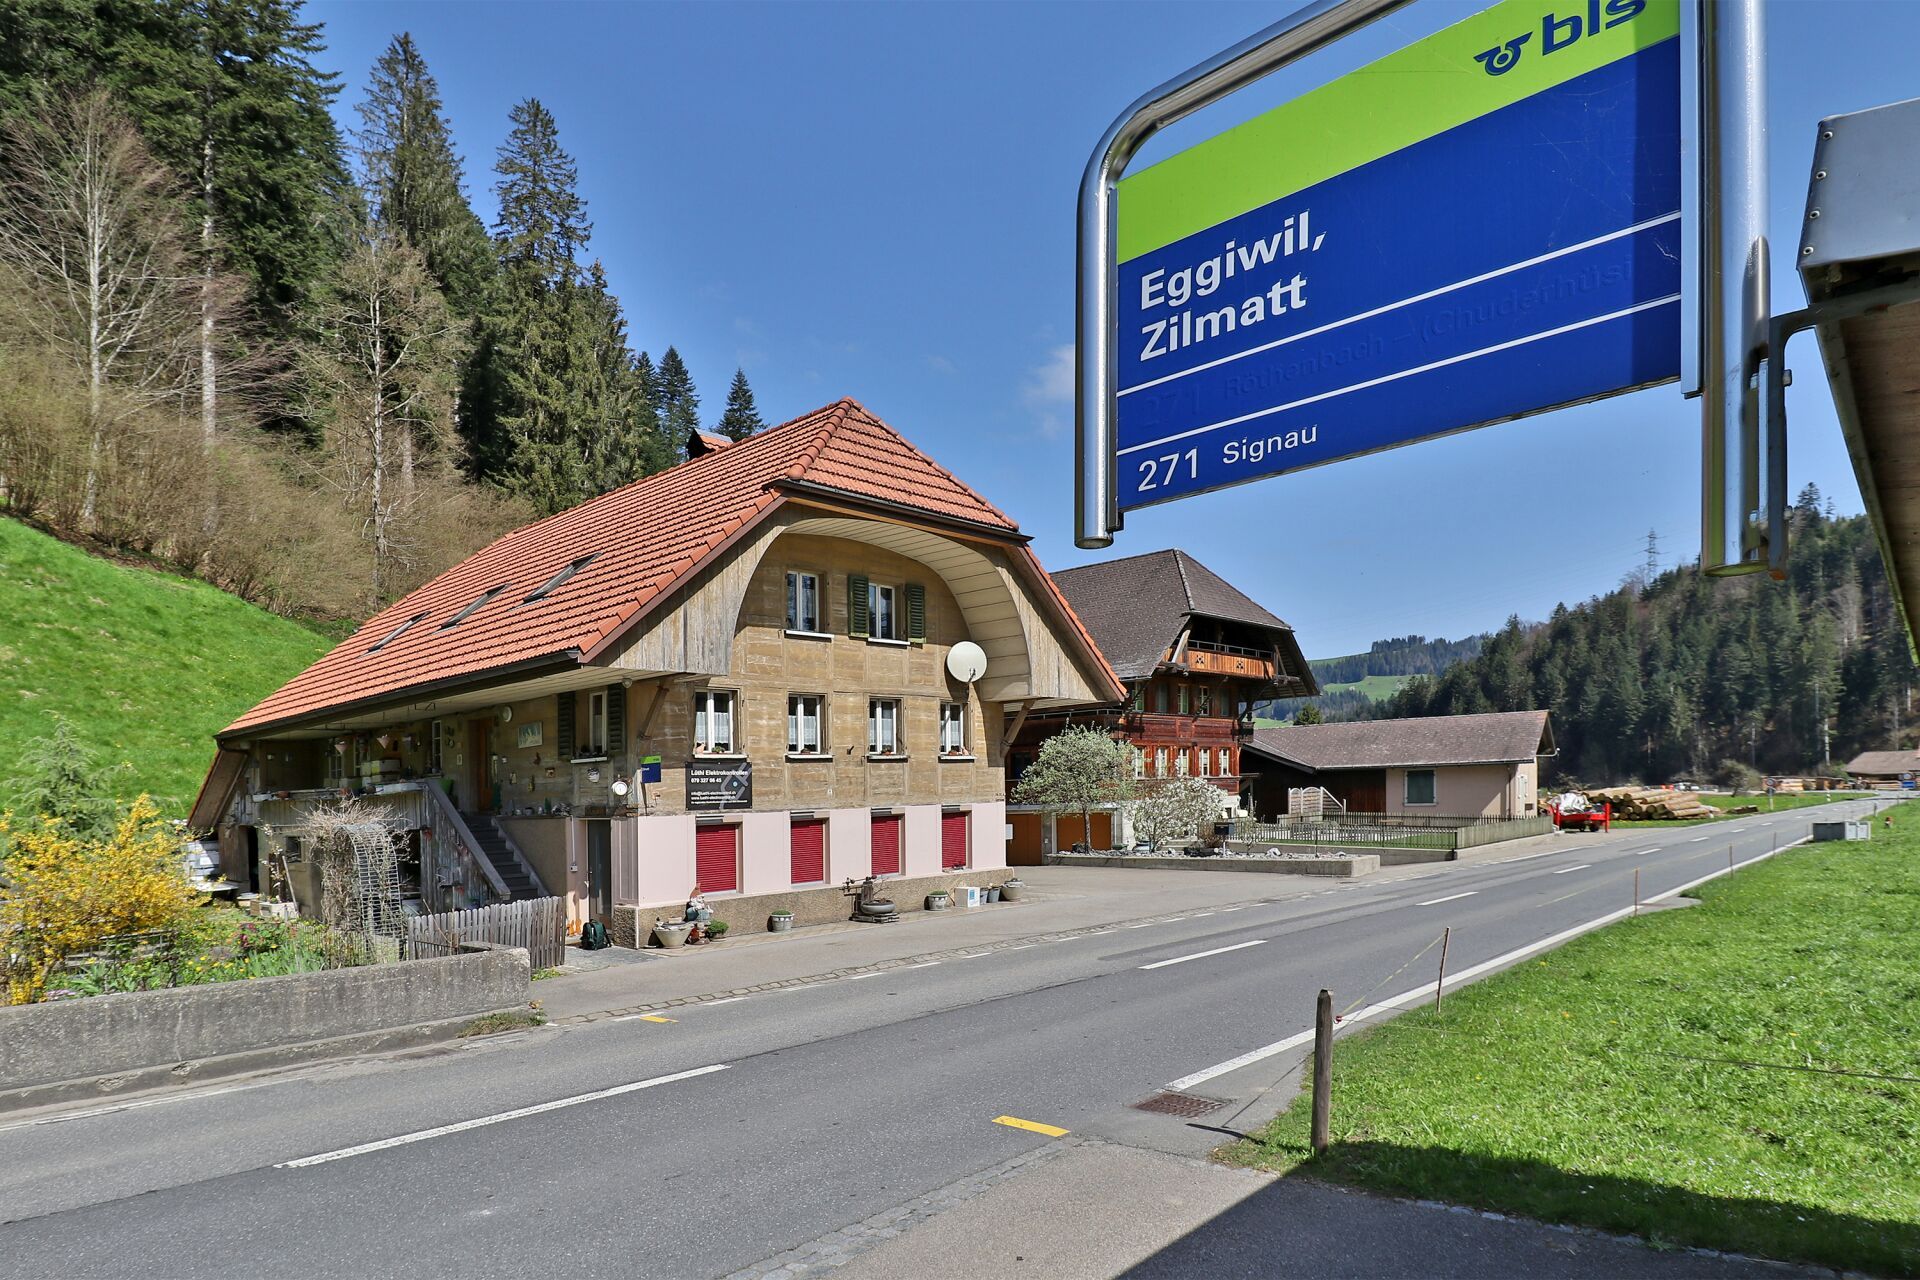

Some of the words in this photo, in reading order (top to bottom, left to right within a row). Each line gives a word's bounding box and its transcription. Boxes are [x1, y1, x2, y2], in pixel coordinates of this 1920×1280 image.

[1542, 0, 1646, 56] bls
[1140, 209, 1327, 310] Eggiwil,
[1139, 272, 1308, 362] Zilmatt
[1137, 446, 1199, 493] 271
[1221, 423, 1319, 464] Signau
